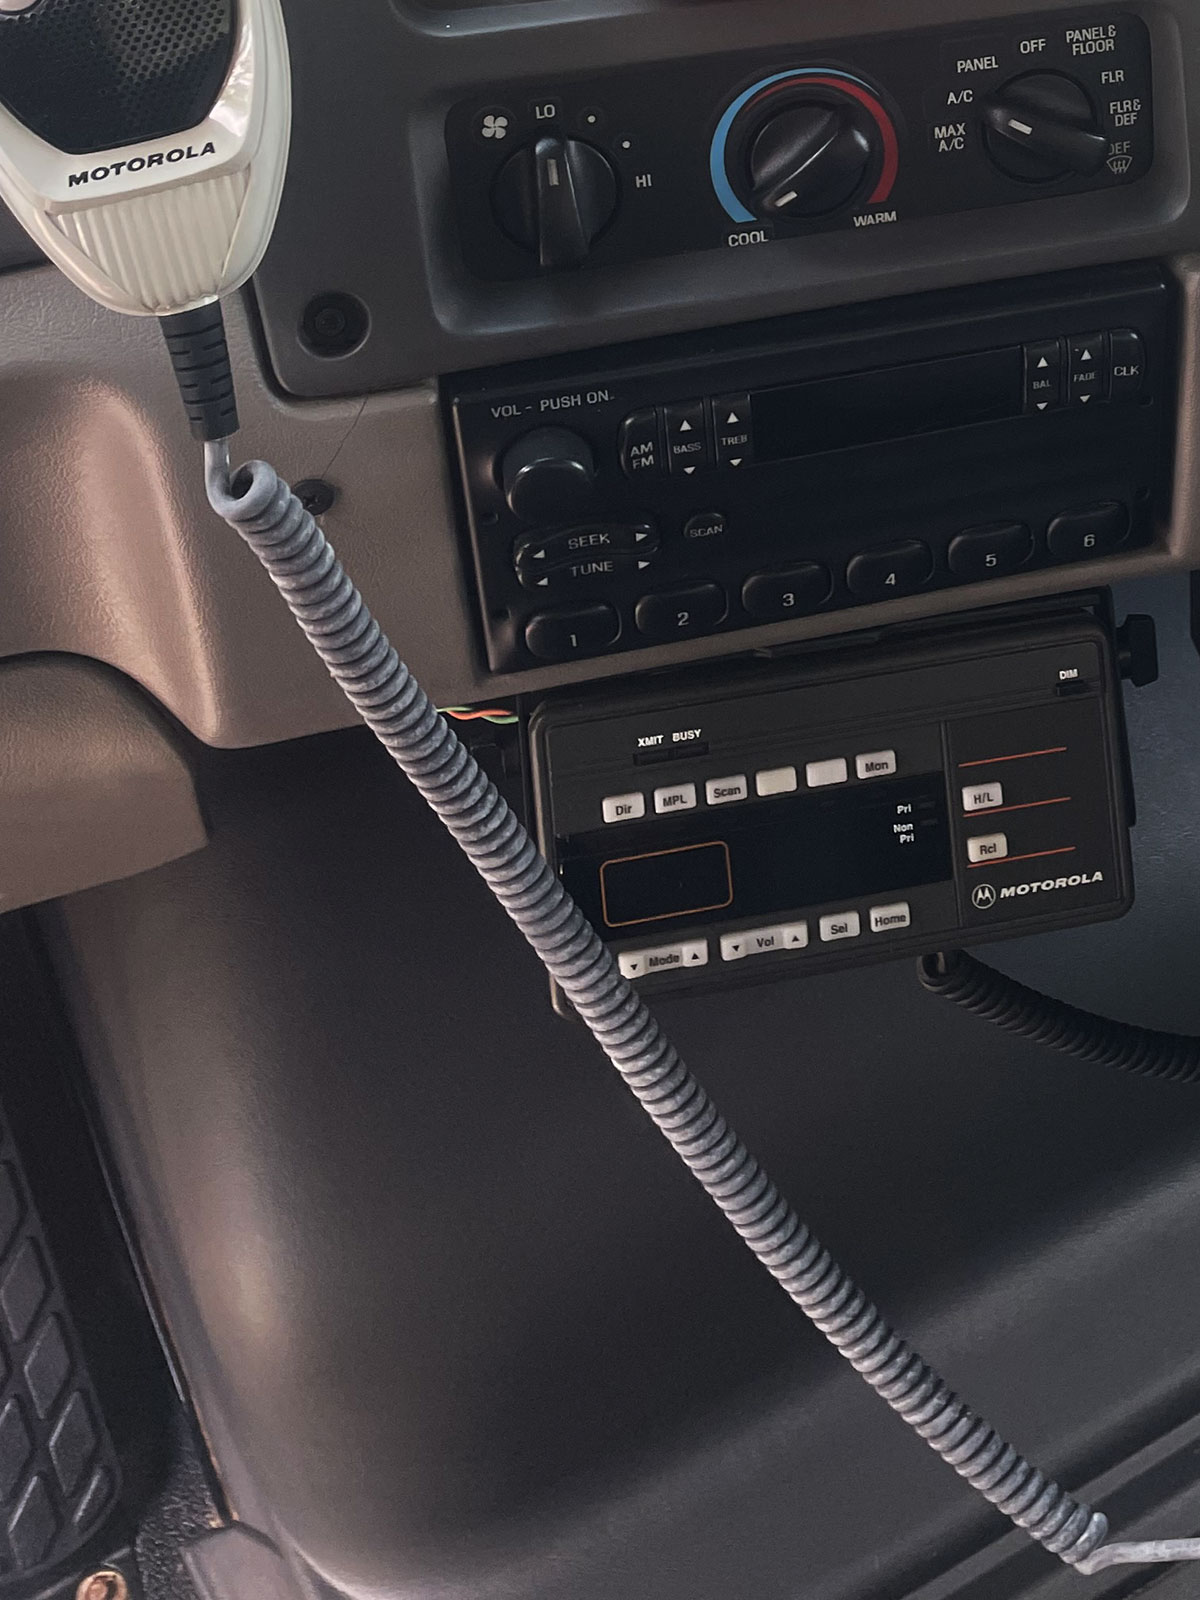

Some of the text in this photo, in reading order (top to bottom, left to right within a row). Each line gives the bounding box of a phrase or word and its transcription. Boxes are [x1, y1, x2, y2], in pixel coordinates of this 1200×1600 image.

[1066, 26, 1106, 43] PANEL
[1020, 38, 1046, 54] OFF
[1072, 39, 1114, 56] FLOOR
[956, 56, 998, 73] PANEL
[1101, 70, 1124, 84] FLR
[947, 89, 974, 105] A/C
[535, 104, 556, 120] LO
[1114, 112, 1138, 127] DEF
[934, 122, 966, 138] MAX
[938, 136, 964, 152] A/C
[68, 141, 216, 188] MOTOROLA
[636, 174, 653, 189] HI
[852, 210, 898, 228] WARM
[728, 230, 768, 248] COOL
[1114, 366, 1140, 376] CLK
[1033, 380, 1052, 390] BAL
[491, 390, 610, 418] VOL PUSH ON
[673, 442, 702, 455] BASS
[721, 434, 748, 447] TREB
[631, 442, 654, 457] AM
[632, 455, 654, 469] FM
[690, 524, 723, 538] SCAN
[568, 532, 611, 550] SEEK
[570, 561, 614, 578] TUNE
[570, 534, 1096, 648] 1 2 3 4 5 6
[1059, 668, 1078, 680] DIM
[638, 729, 702, 748] XMIT BUSY
[616, 760, 889, 816] Dir MPL Scan Mon
[974, 792, 994, 804] H/L
[894, 823, 914, 834] Non
[900, 832, 914, 844] Pri
[980, 842, 997, 855] Rcl
[1000, 872, 1103, 899] MOTOROLA
[649, 912, 906, 967] Mode Vol Sel Home
